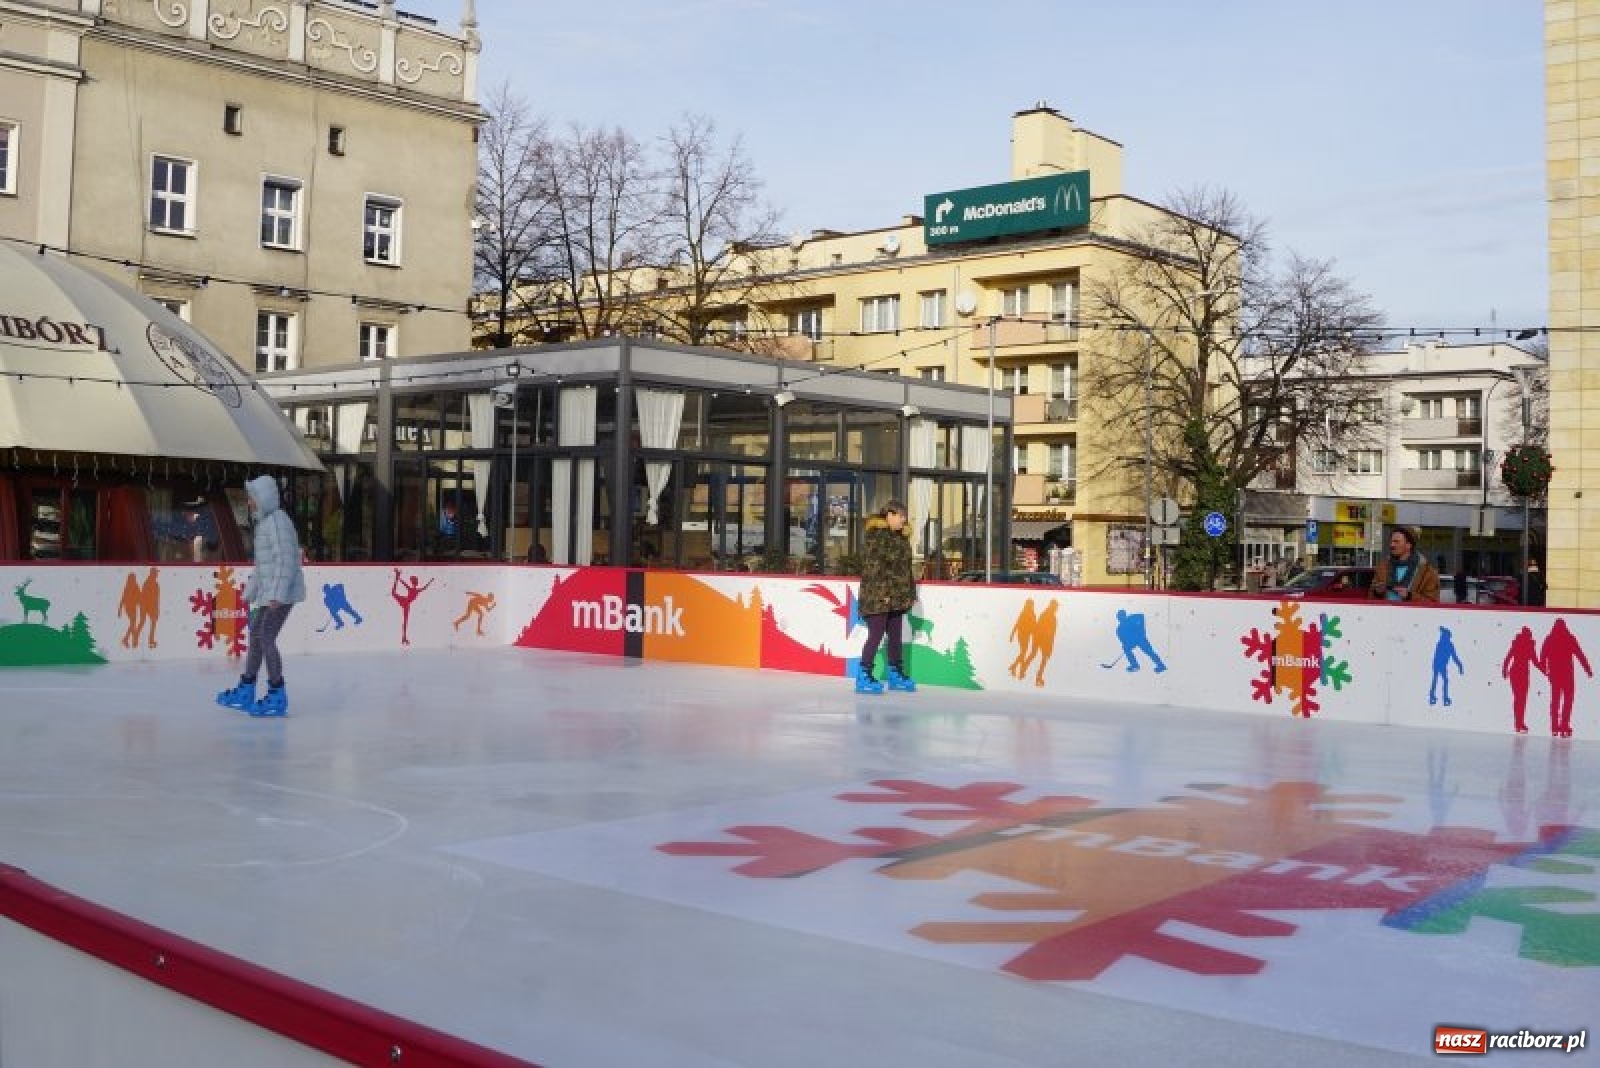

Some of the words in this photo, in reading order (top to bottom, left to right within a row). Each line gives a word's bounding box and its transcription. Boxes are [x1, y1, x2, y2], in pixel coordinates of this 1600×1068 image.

[963, 195, 1046, 221] McDonald's
[0, 314, 121, 354] IBÓRZ
[571, 594, 686, 637] mBank
[1271, 654, 1320, 668] mBank
[993, 823, 1435, 893] mBank
